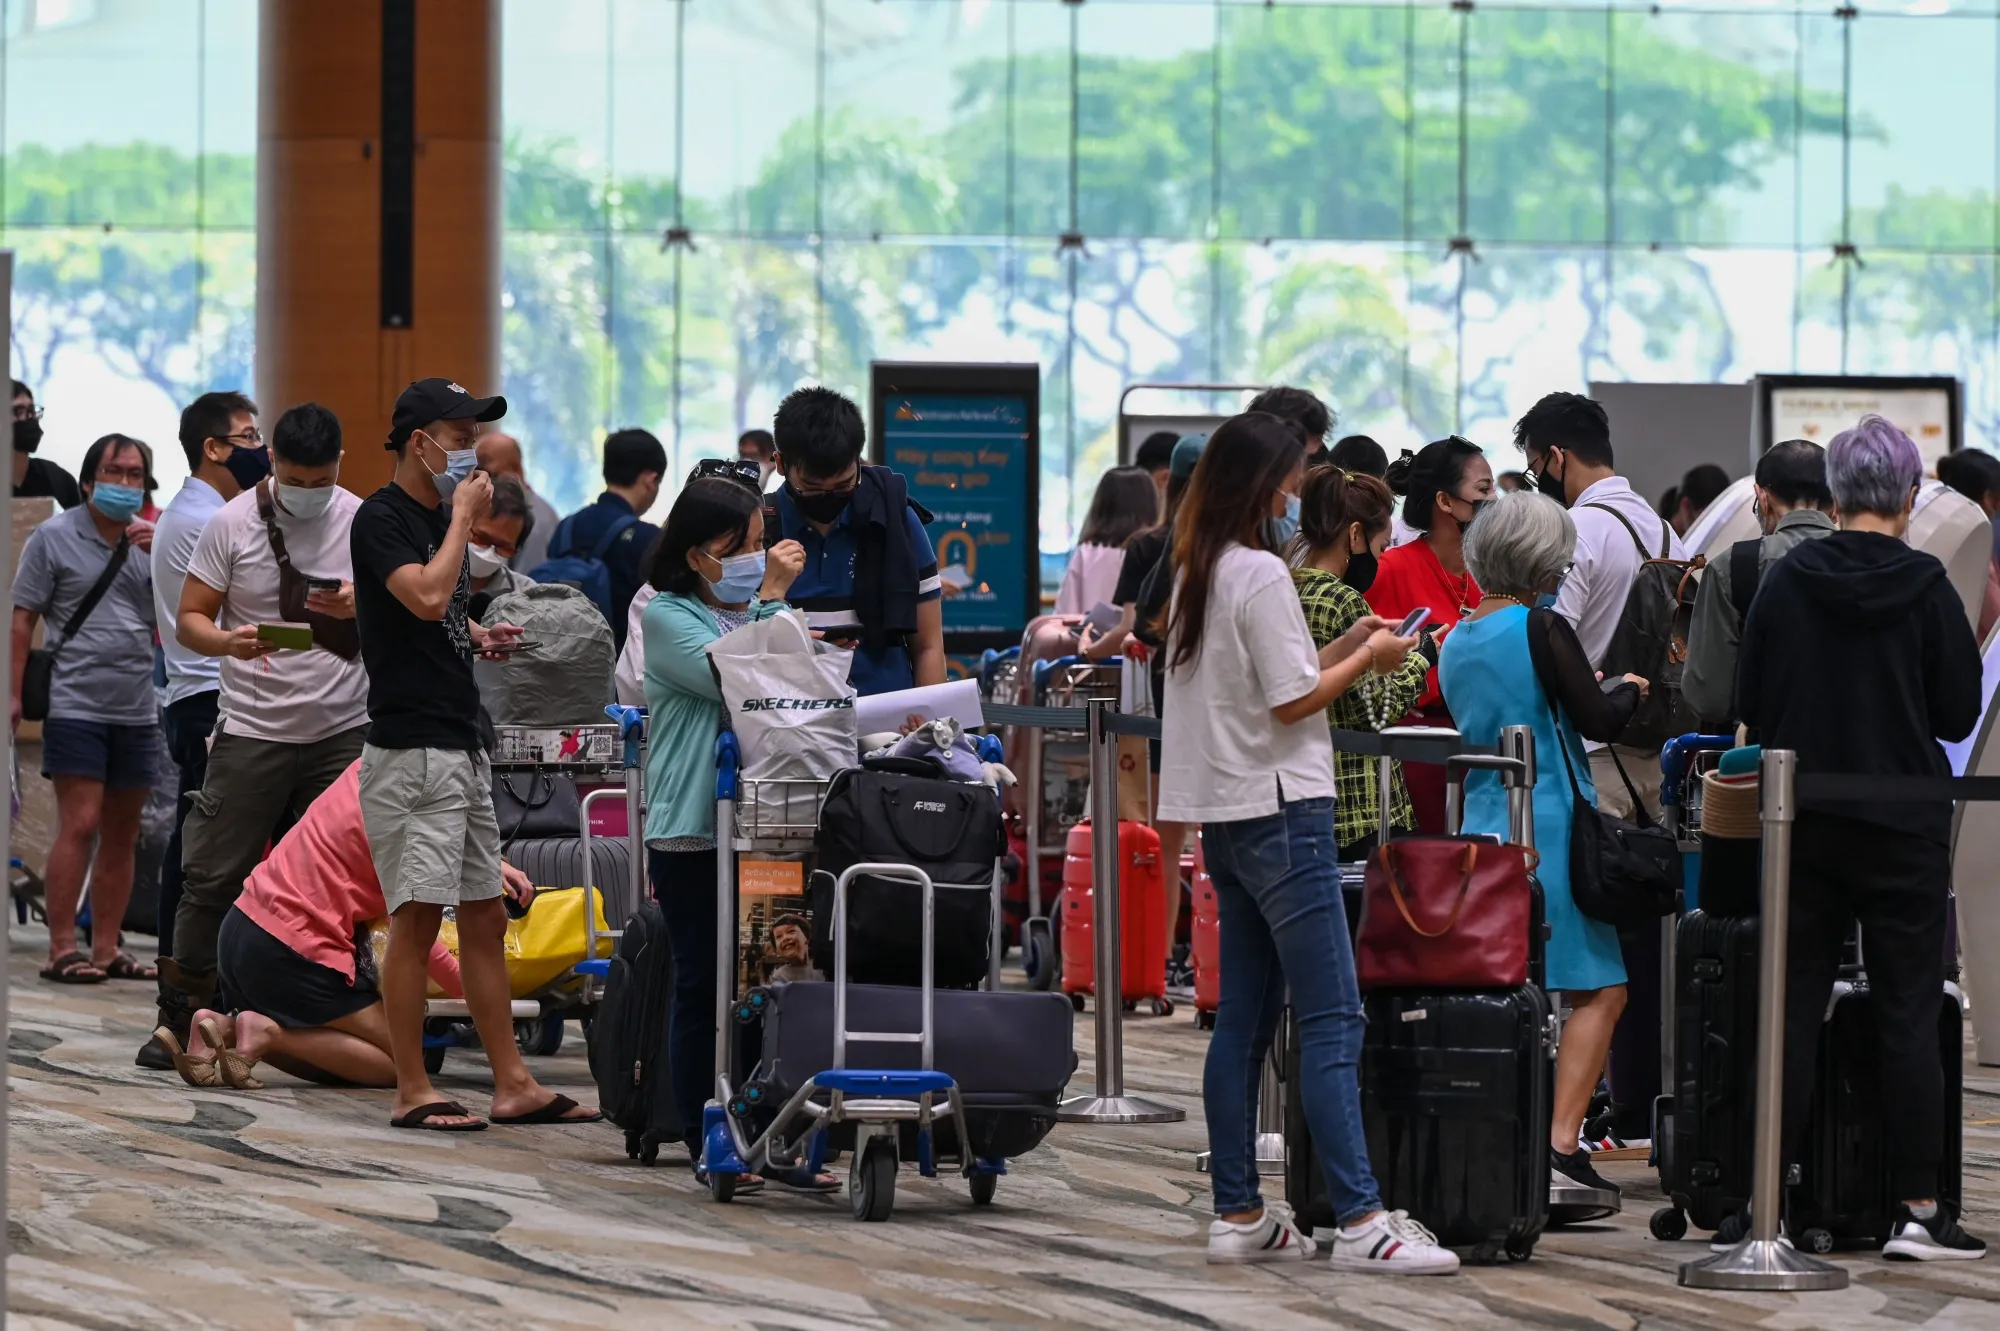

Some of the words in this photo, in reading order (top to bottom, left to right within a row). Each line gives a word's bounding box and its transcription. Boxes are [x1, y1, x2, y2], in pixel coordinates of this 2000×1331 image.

[741, 695, 853, 712] SKECHERS
[772, 869, 784, 877] the
[744, 879, 752, 887] of
